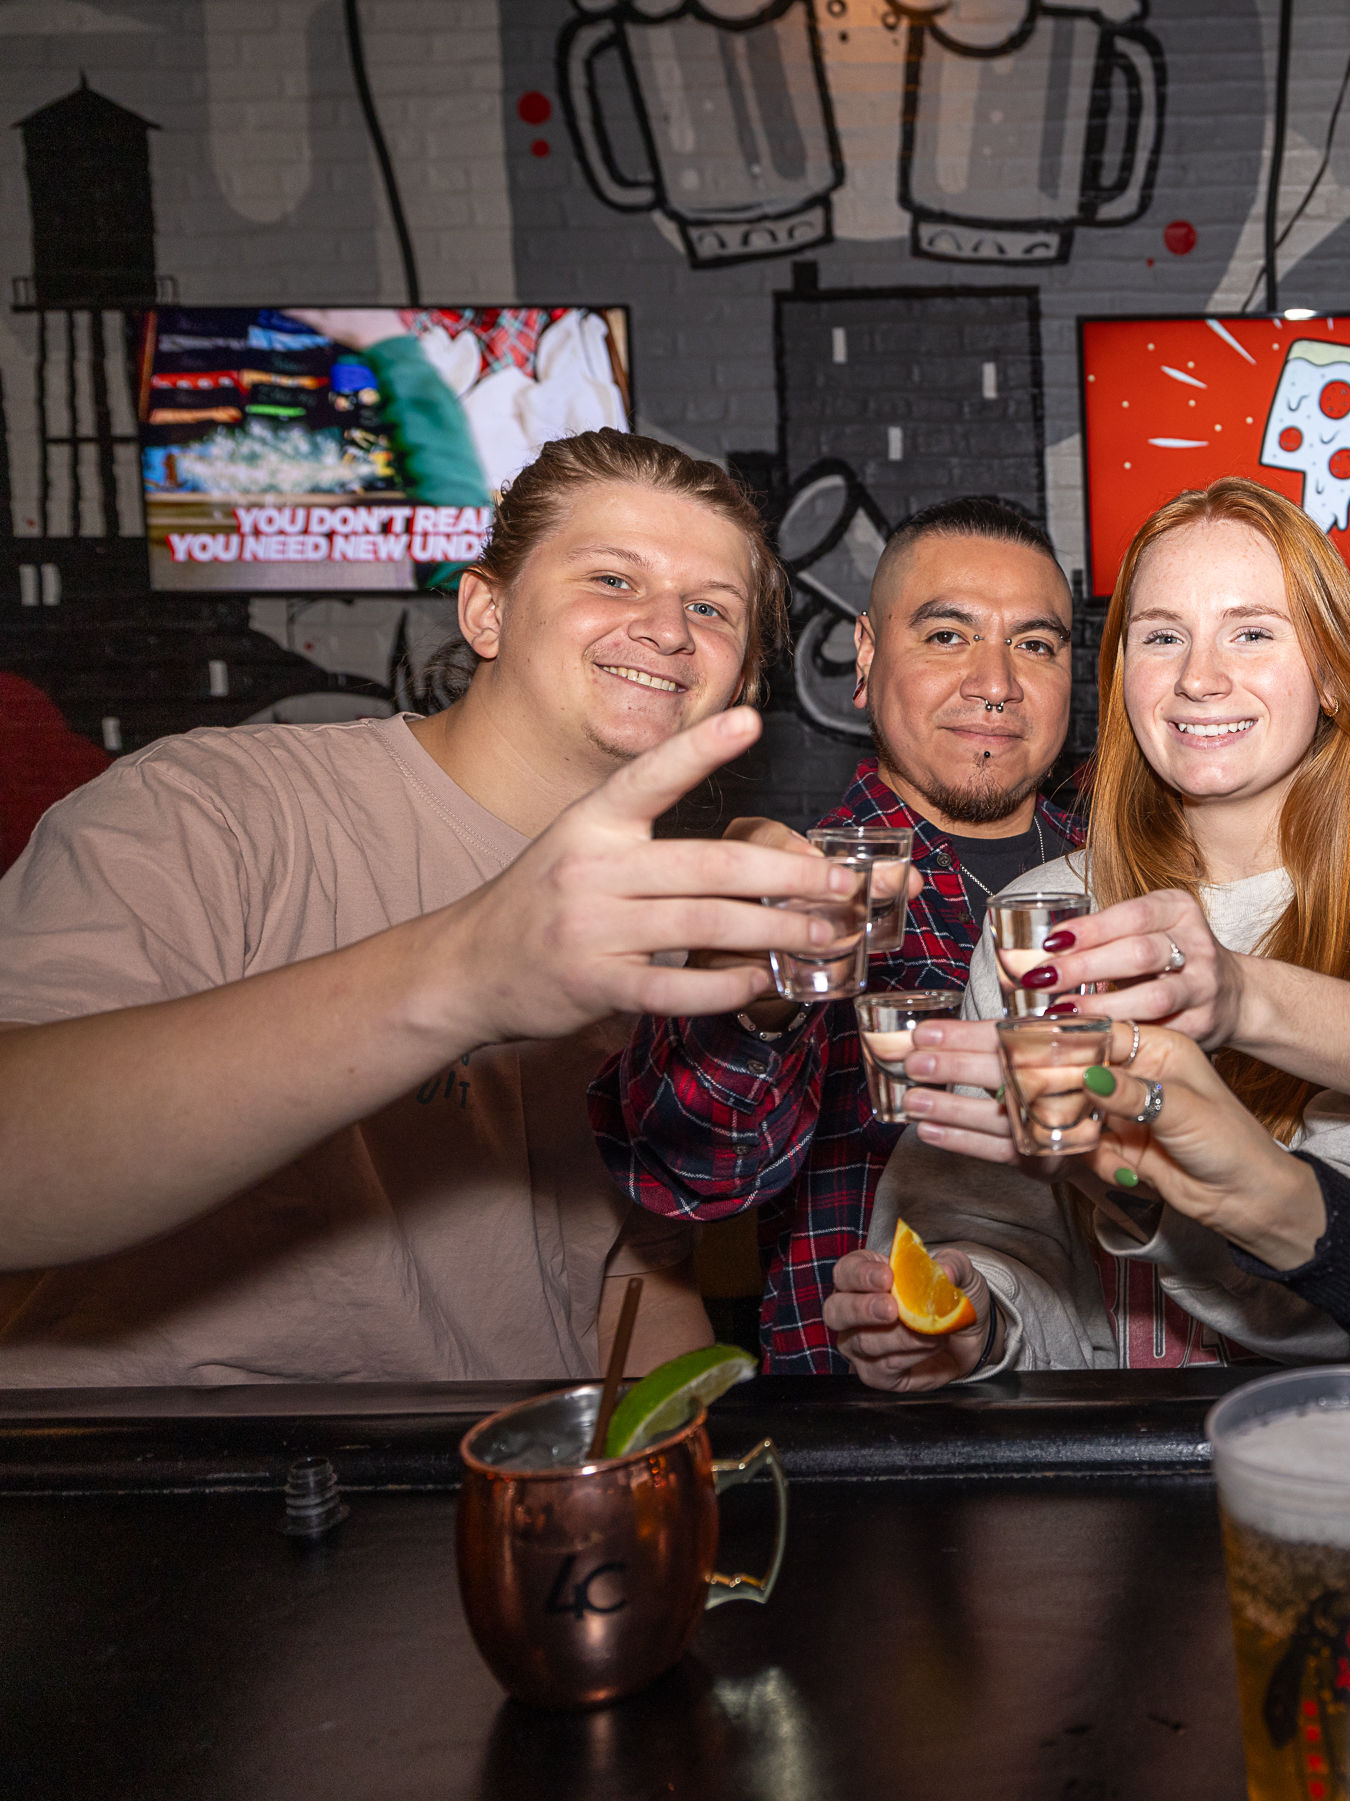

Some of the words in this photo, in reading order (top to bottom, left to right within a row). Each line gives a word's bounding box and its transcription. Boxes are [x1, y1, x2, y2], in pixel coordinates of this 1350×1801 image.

[233, 507, 307, 535] YOU
[307, 506, 412, 535] DON'T
[165, 533, 240, 562] YOU
[240, 533, 330, 562] NEED
[329, 533, 410, 562] NEW
[409, 533, 486, 562] UND
[546, 1553, 626, 1619] 4C
